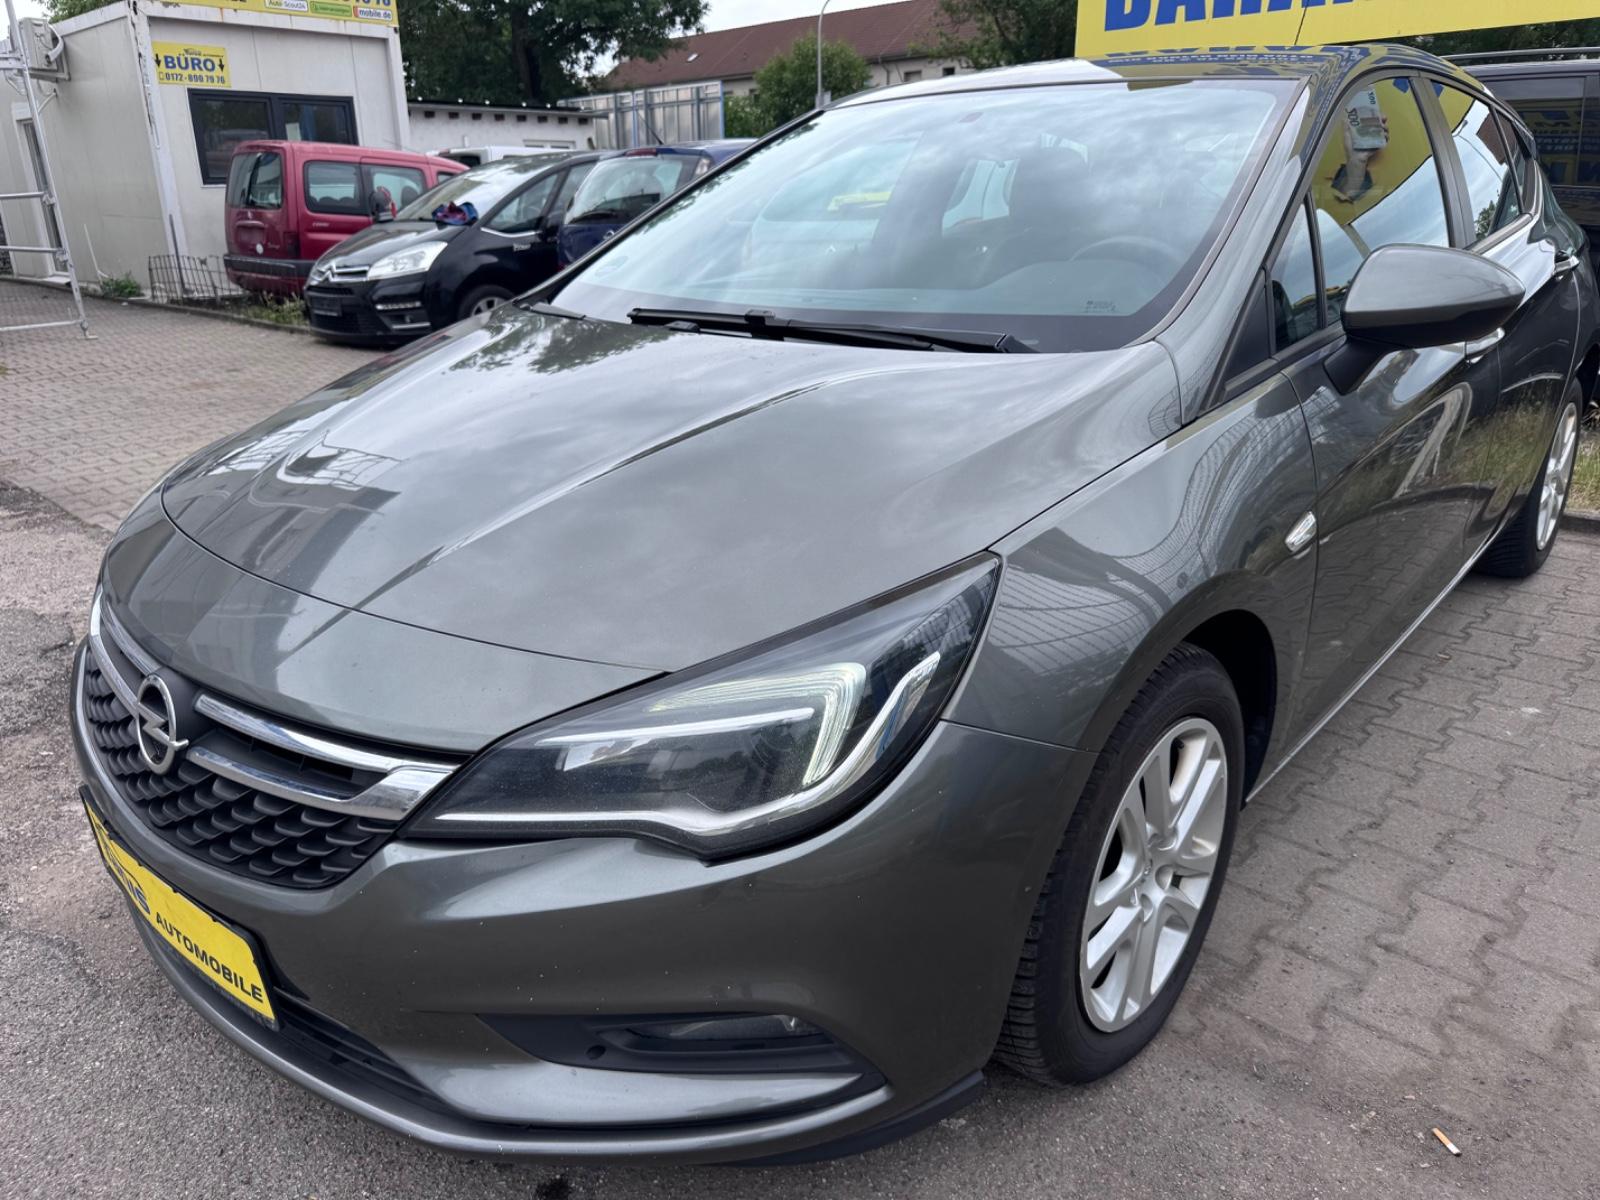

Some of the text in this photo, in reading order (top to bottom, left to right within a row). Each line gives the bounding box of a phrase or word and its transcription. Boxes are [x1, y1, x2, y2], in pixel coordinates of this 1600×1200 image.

[359, 9, 391, 19] mobile.de
[163, 53, 216, 72] BÜRO
[155, 911, 264, 1004] AUTOMOBILE
